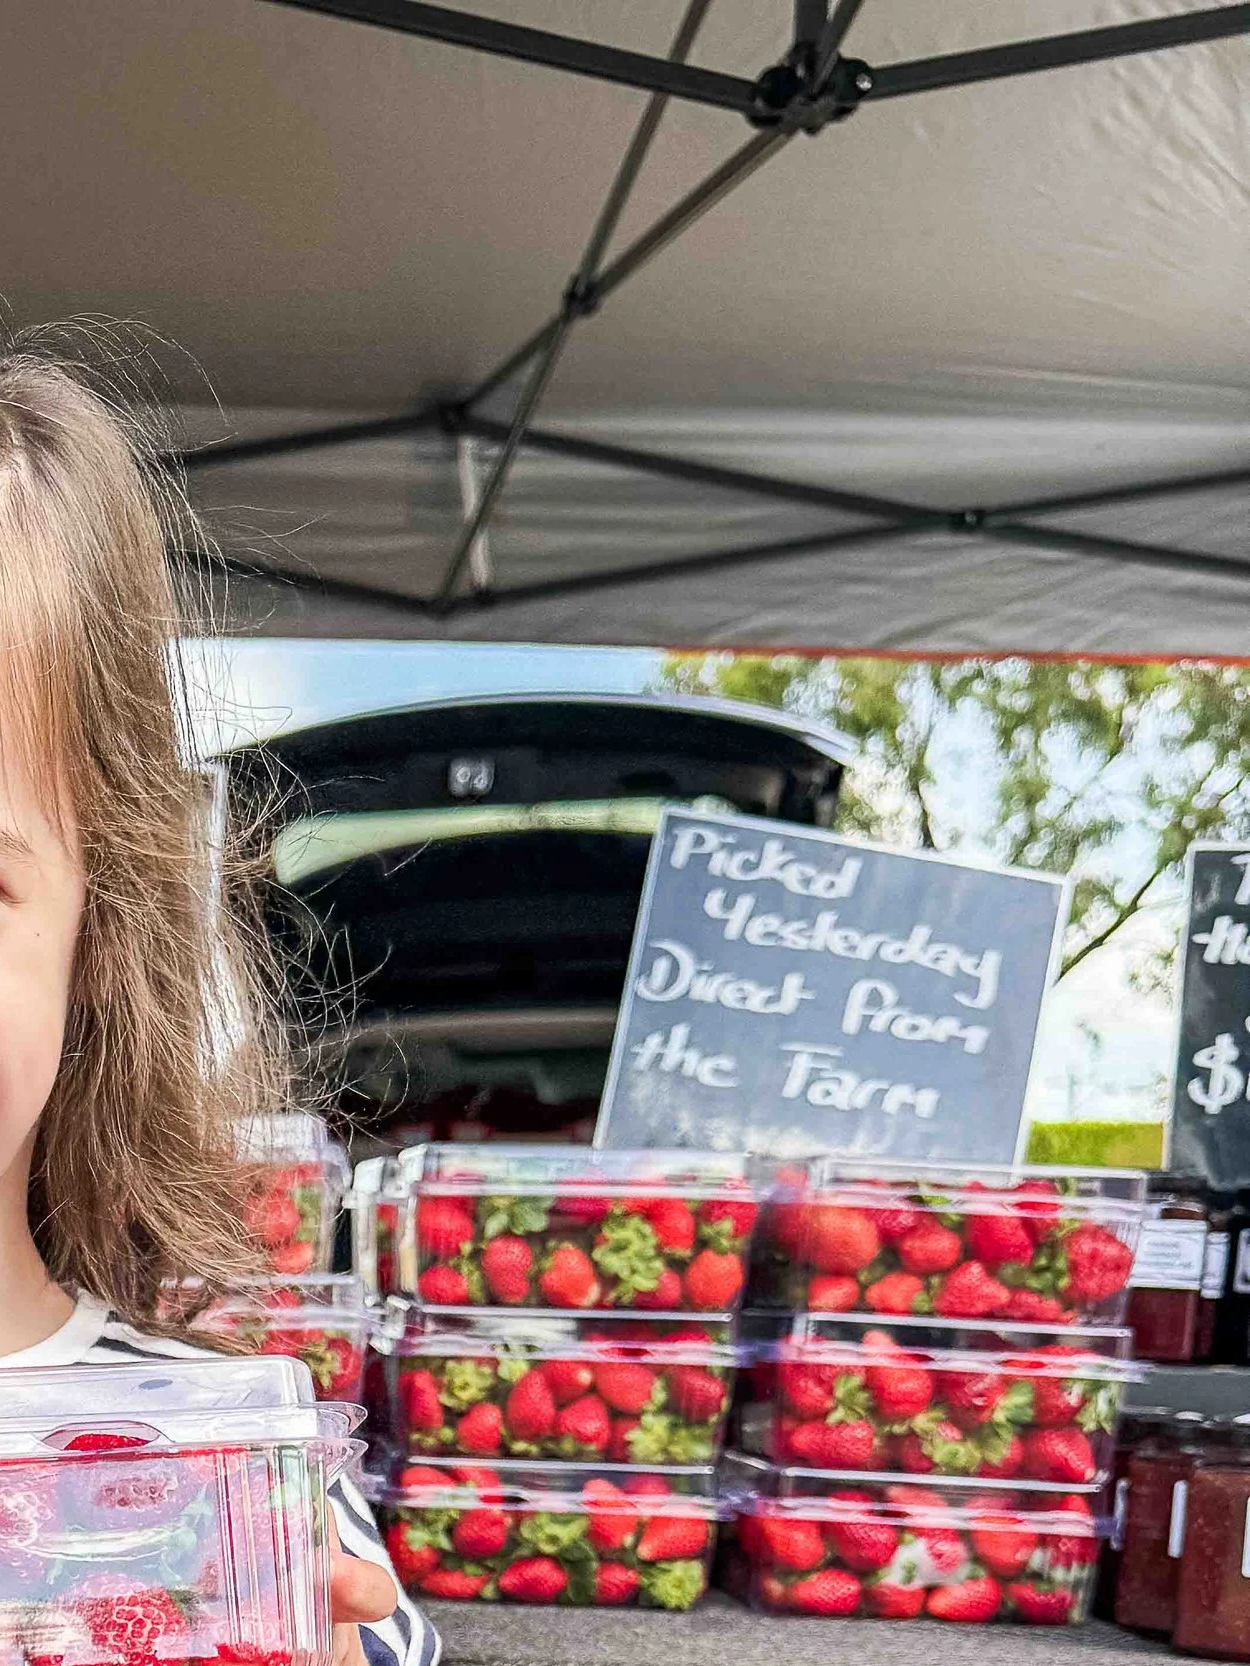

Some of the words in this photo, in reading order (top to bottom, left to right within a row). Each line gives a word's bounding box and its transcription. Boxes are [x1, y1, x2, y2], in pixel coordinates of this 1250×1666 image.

[669, 826, 863, 899] Picked
[635, 938, 816, 1016] Direct
[703, 887, 1003, 1010] Yesterday
[630, 1022, 739, 1088] the
[779, 1041, 941, 1119] Farm
